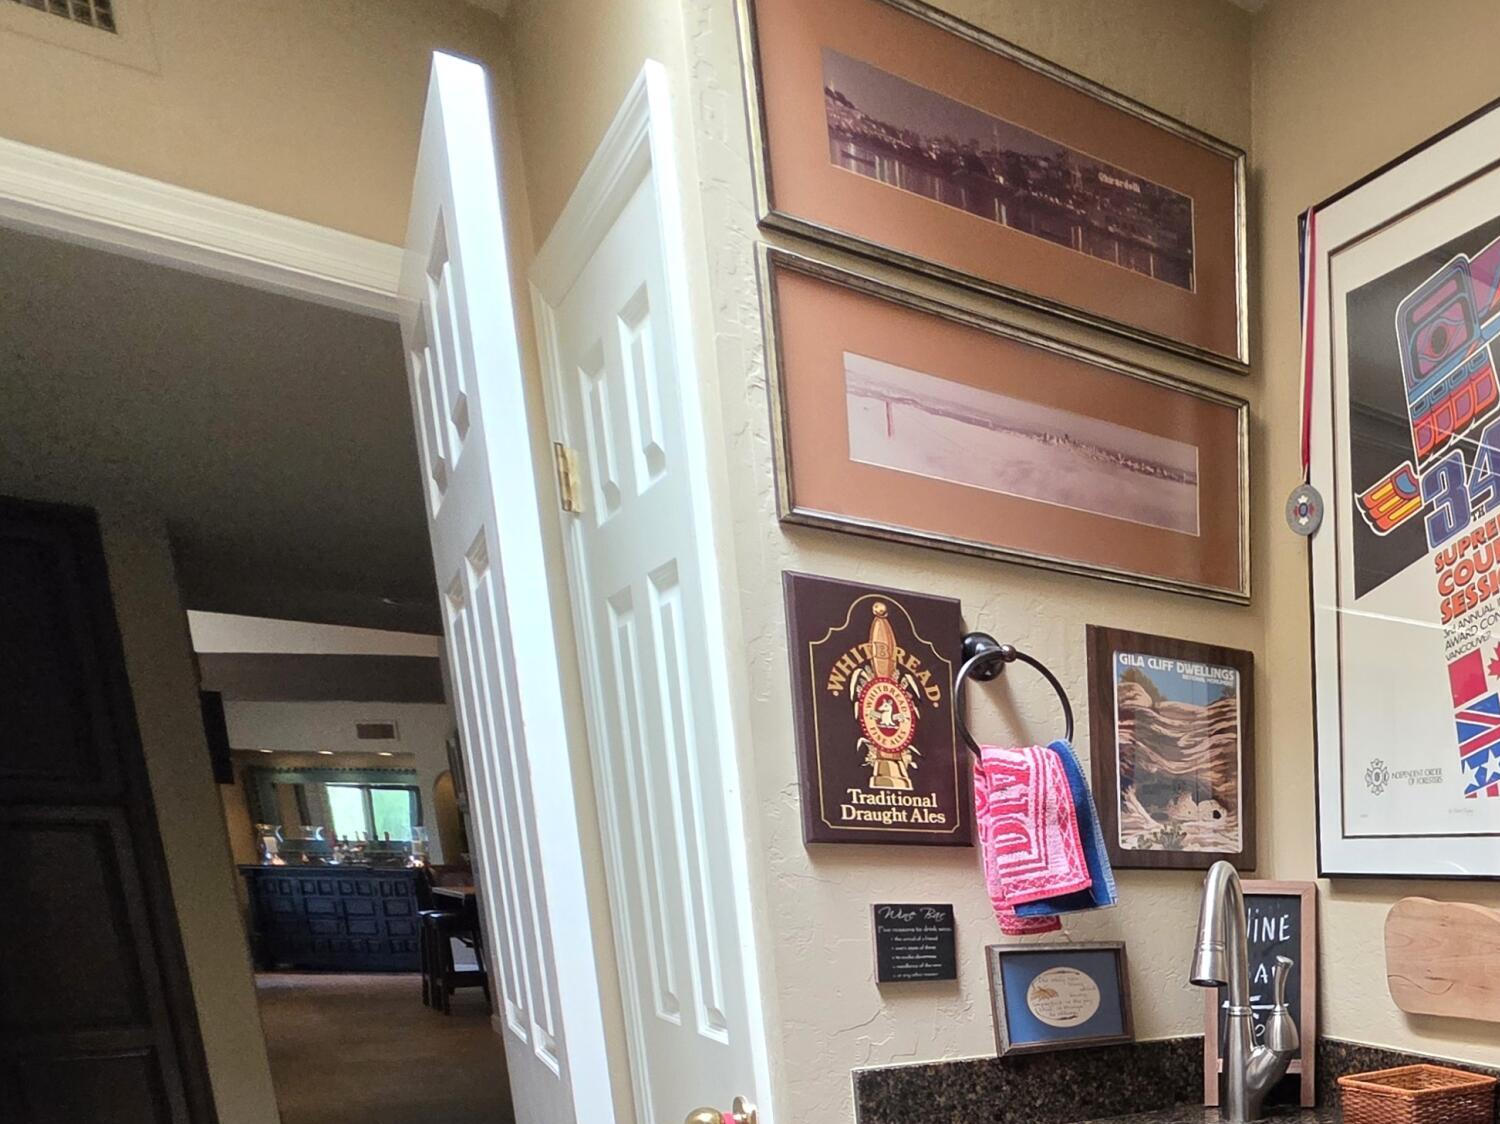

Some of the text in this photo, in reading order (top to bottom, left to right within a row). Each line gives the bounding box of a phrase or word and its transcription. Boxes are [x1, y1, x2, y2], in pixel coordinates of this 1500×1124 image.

[1458, 602, 1495, 629] ANNUAL
[1119, 653, 1235, 681] GILA CLIFF DWELLINGS
[846, 788, 938, 808] Traditional
[840, 804, 946, 825] Draught Ales
